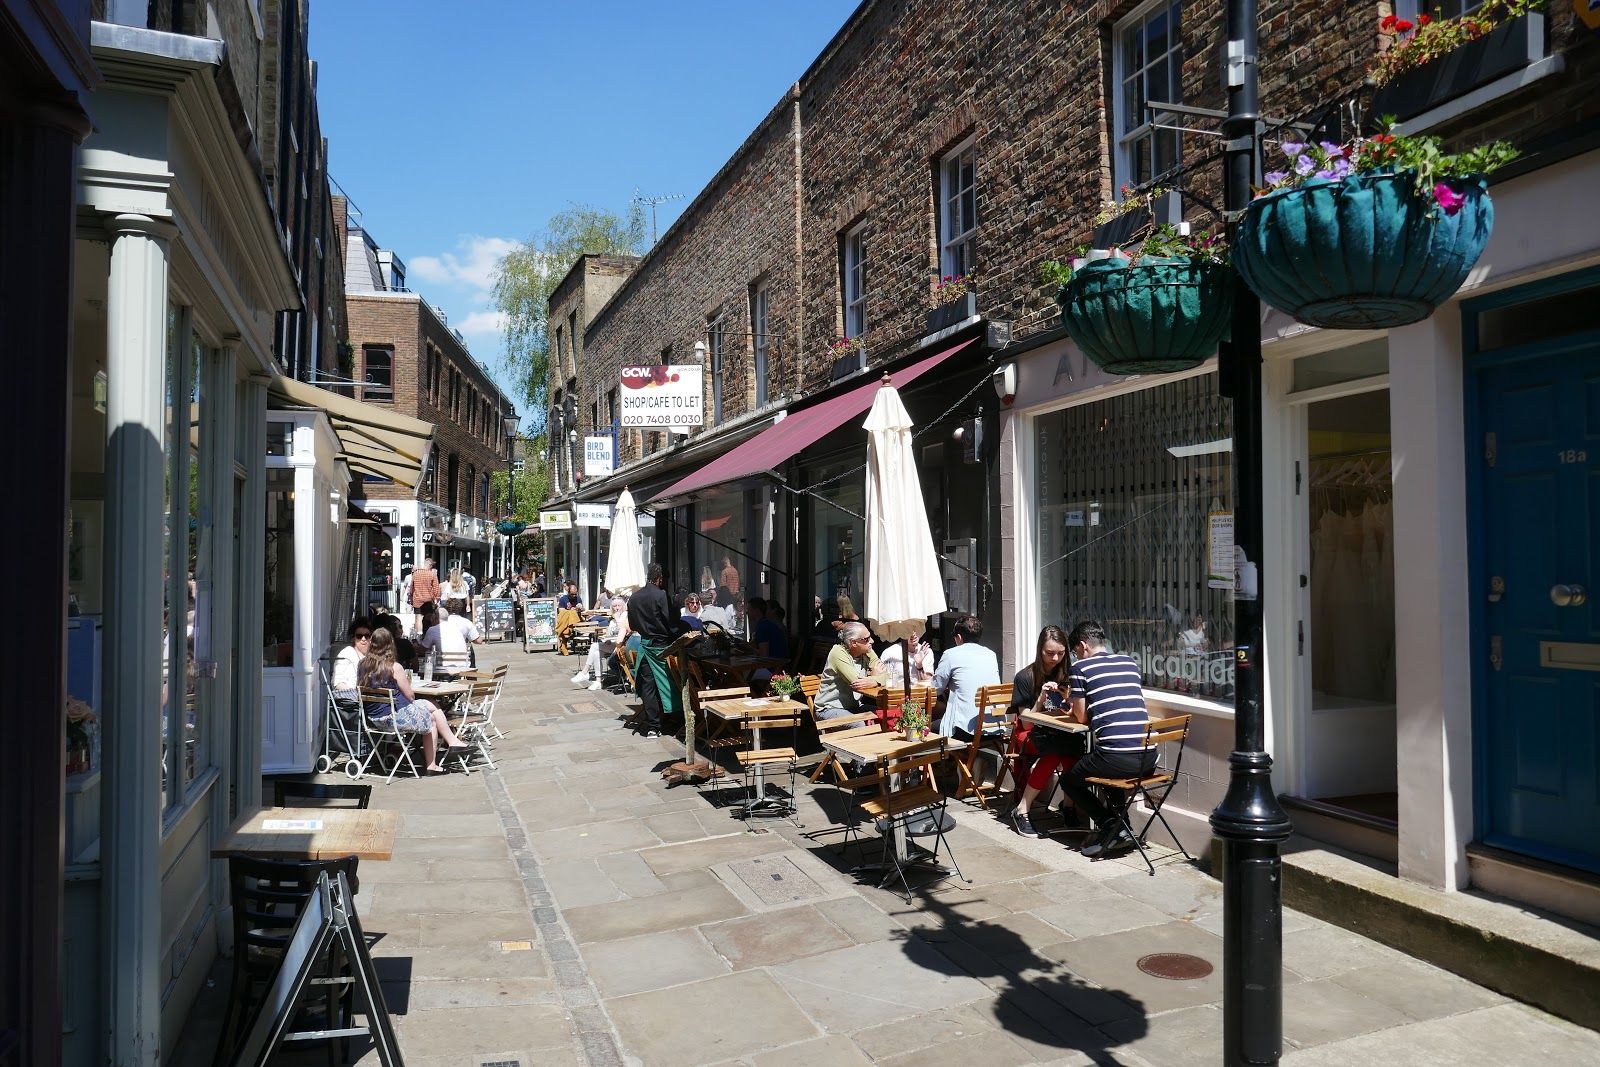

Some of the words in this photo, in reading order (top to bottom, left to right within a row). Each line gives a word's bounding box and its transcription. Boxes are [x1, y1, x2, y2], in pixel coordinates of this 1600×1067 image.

[671, 395, 683, 408] TO
[684, 395, 700, 408] LET
[623, 415, 644, 424] 020
[645, 415, 671, 424] 7408
[673, 414, 701, 424] 0030
[586, 441, 604, 451] BIRD
[586, 451, 611, 461] BLEND
[1557, 449, 1587, 465] 18a
[422, 533, 432, 541] 47
